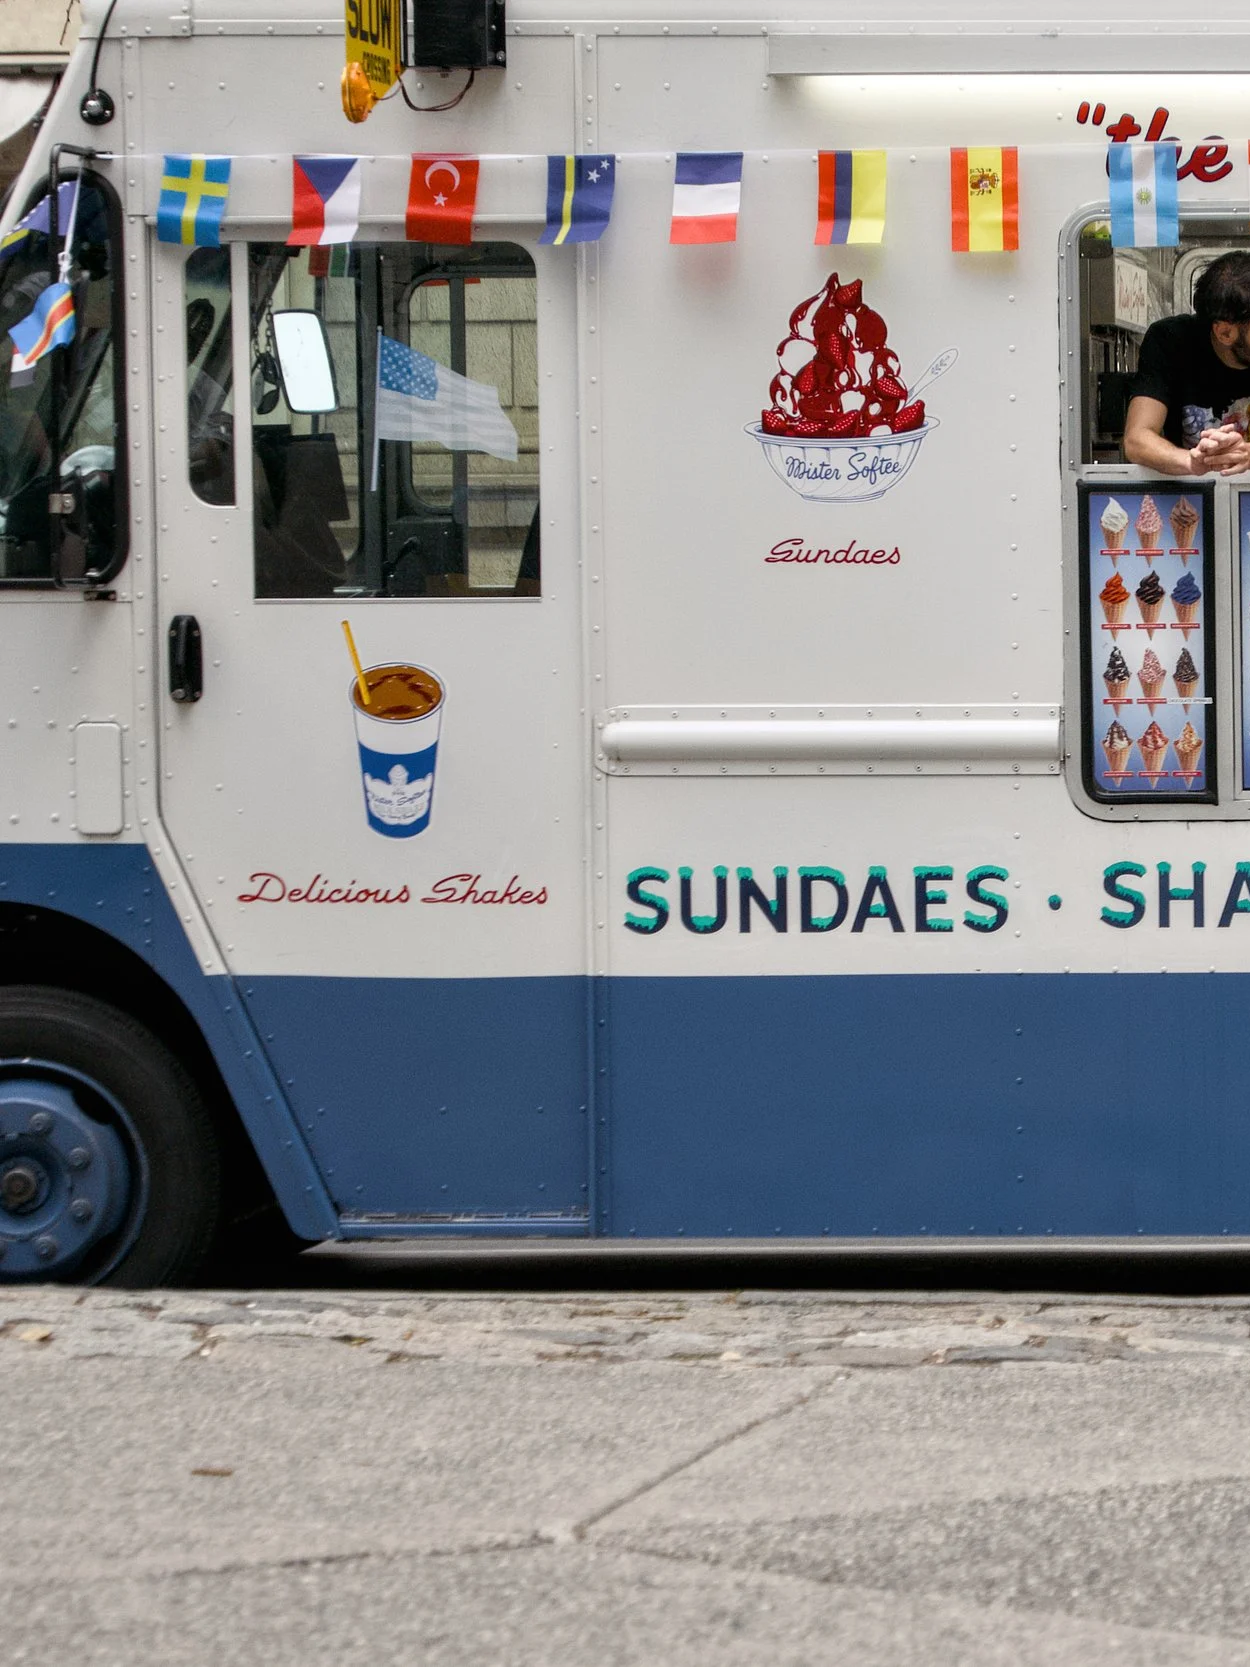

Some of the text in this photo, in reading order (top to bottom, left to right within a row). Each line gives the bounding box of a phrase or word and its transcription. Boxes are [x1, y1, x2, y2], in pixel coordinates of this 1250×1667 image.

[785, 452, 902, 485] Mister Softee
[764, 538, 901, 565] Sundaes
[237, 873, 549, 905] Delicious Shakes
[624, 864, 1011, 935] SUNDAES
